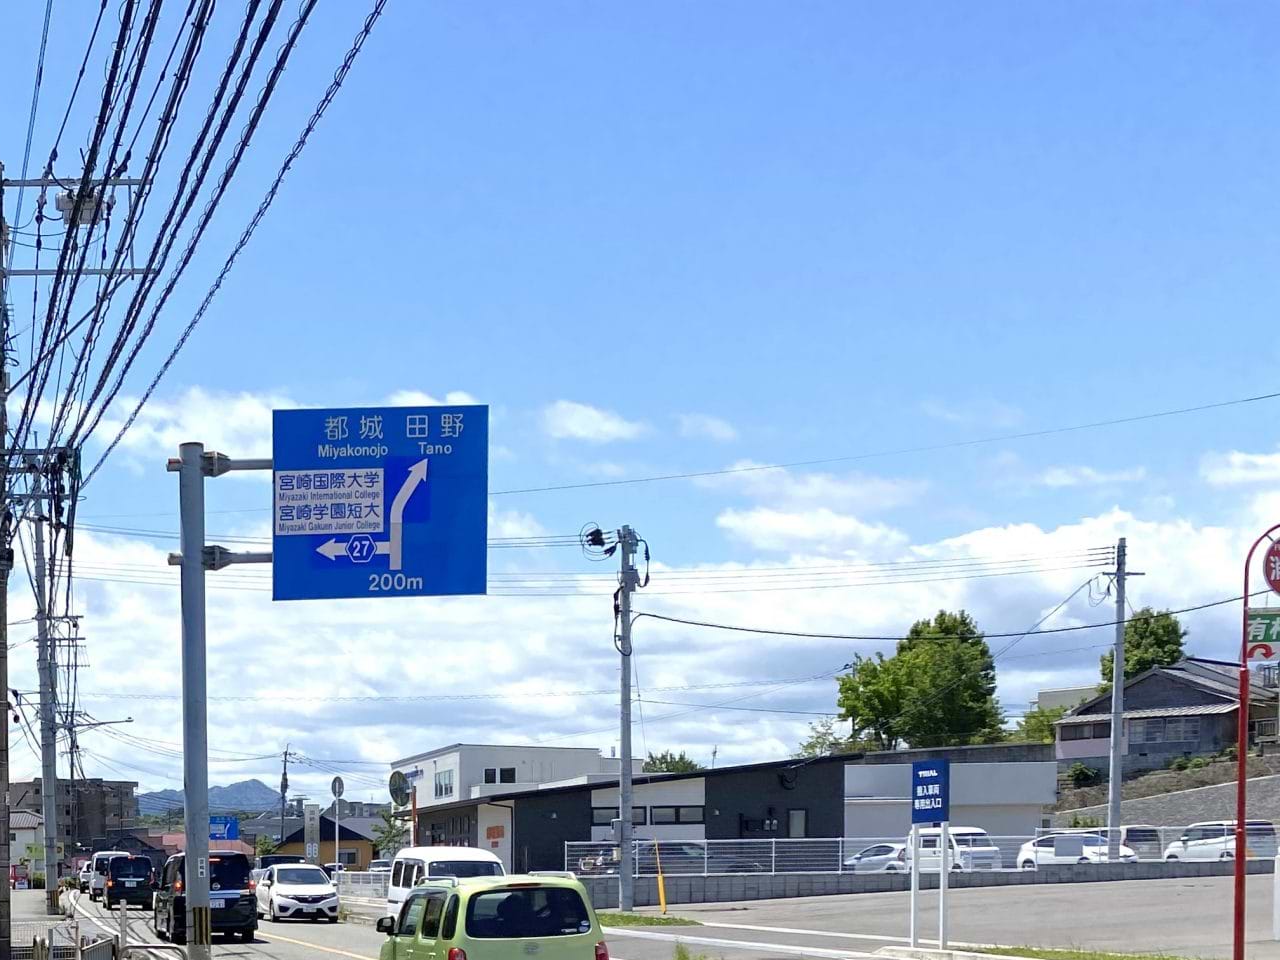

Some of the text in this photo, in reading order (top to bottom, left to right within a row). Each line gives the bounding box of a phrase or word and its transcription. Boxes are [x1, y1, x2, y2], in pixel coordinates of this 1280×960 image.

[323, 413, 464, 440] 都城 田野
[318, 442, 452, 460] Miyakonojo Tano
[279, 472, 380, 491] 宮崎国際大学
[279, 489, 380, 503] Miyazaki International College
[279, 502, 380, 521] 宮崎学園短大
[279, 520, 380, 534] Miyazaki Gakuen Junior College
[352, 540, 370, 557] 27
[368, 573, 423, 591] 200m
